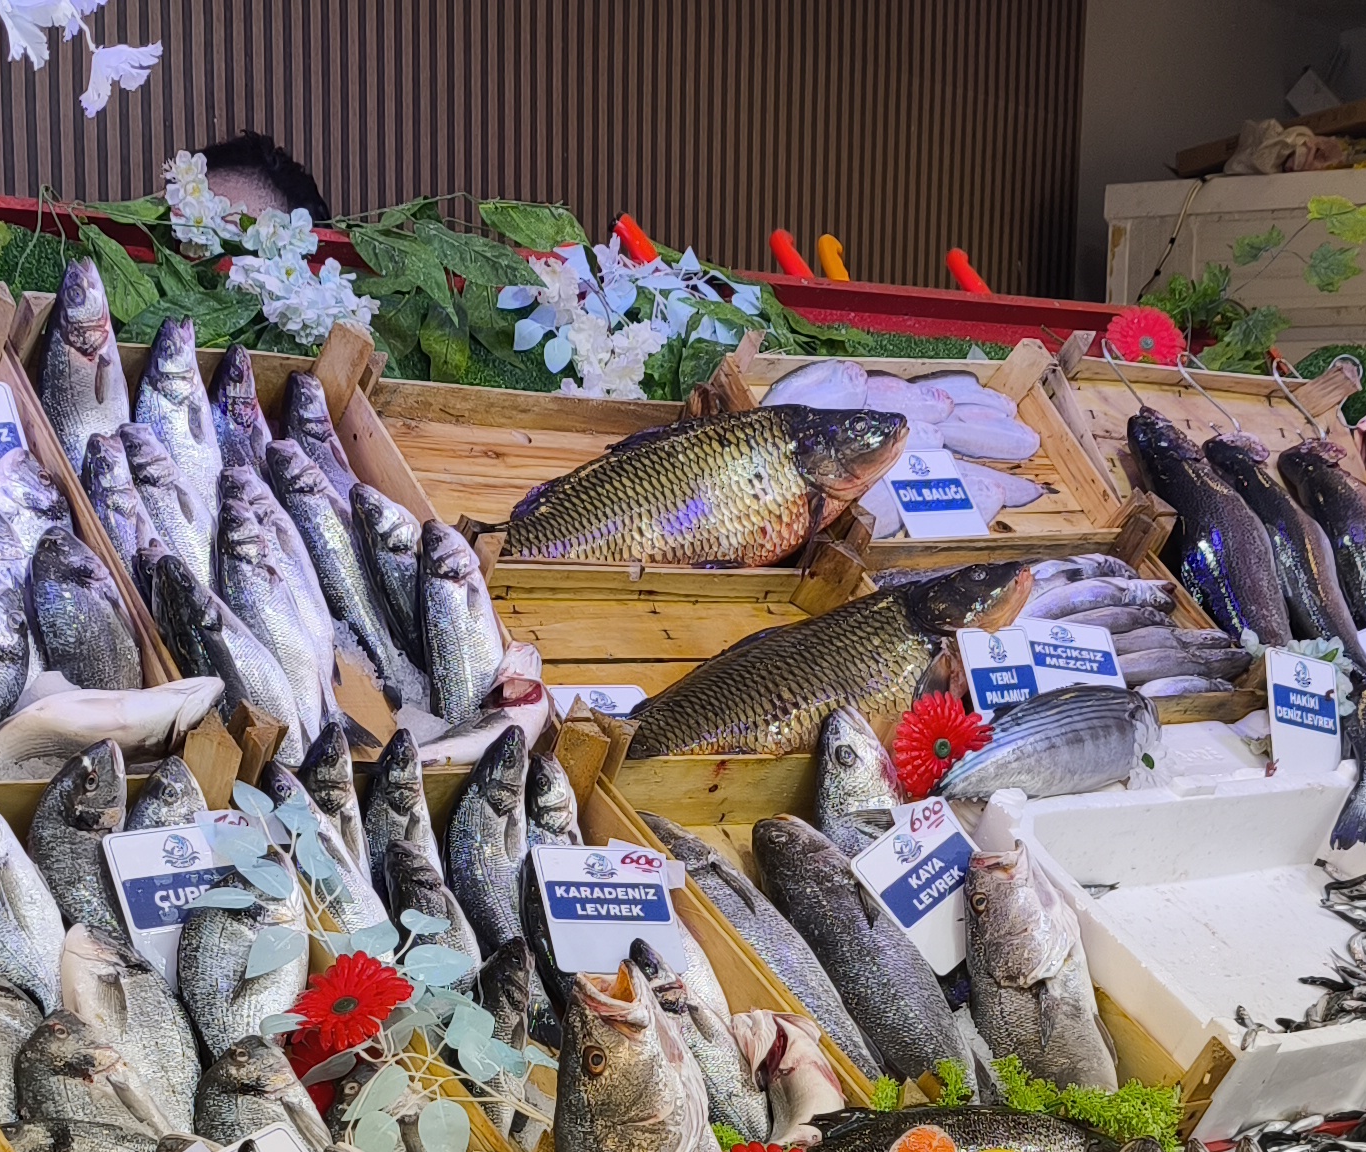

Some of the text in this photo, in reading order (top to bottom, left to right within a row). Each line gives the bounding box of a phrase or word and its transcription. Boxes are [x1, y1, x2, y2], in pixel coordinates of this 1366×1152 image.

[898, 484, 966, 502] DİL BALIĞI
[1034, 643, 1105, 662] KILÇIKSIZ
[1045, 656, 1099, 672] MEZGİT
[989, 668, 1019, 686] YERLİ
[985, 688, 1030, 705] PALAMUT
[1289, 691, 1320, 711] HAKİKİ
[1276, 705, 1336, 731] DENİZ LEVREK
[909, 800, 944, 833] 600
[620, 850, 663, 869] 600
[907, 857, 946, 889] KAYA
[554, 885, 658, 901] KARADENİZ
[912, 865, 965, 911] LEVREK
[575, 903, 645, 917] LEVREK
